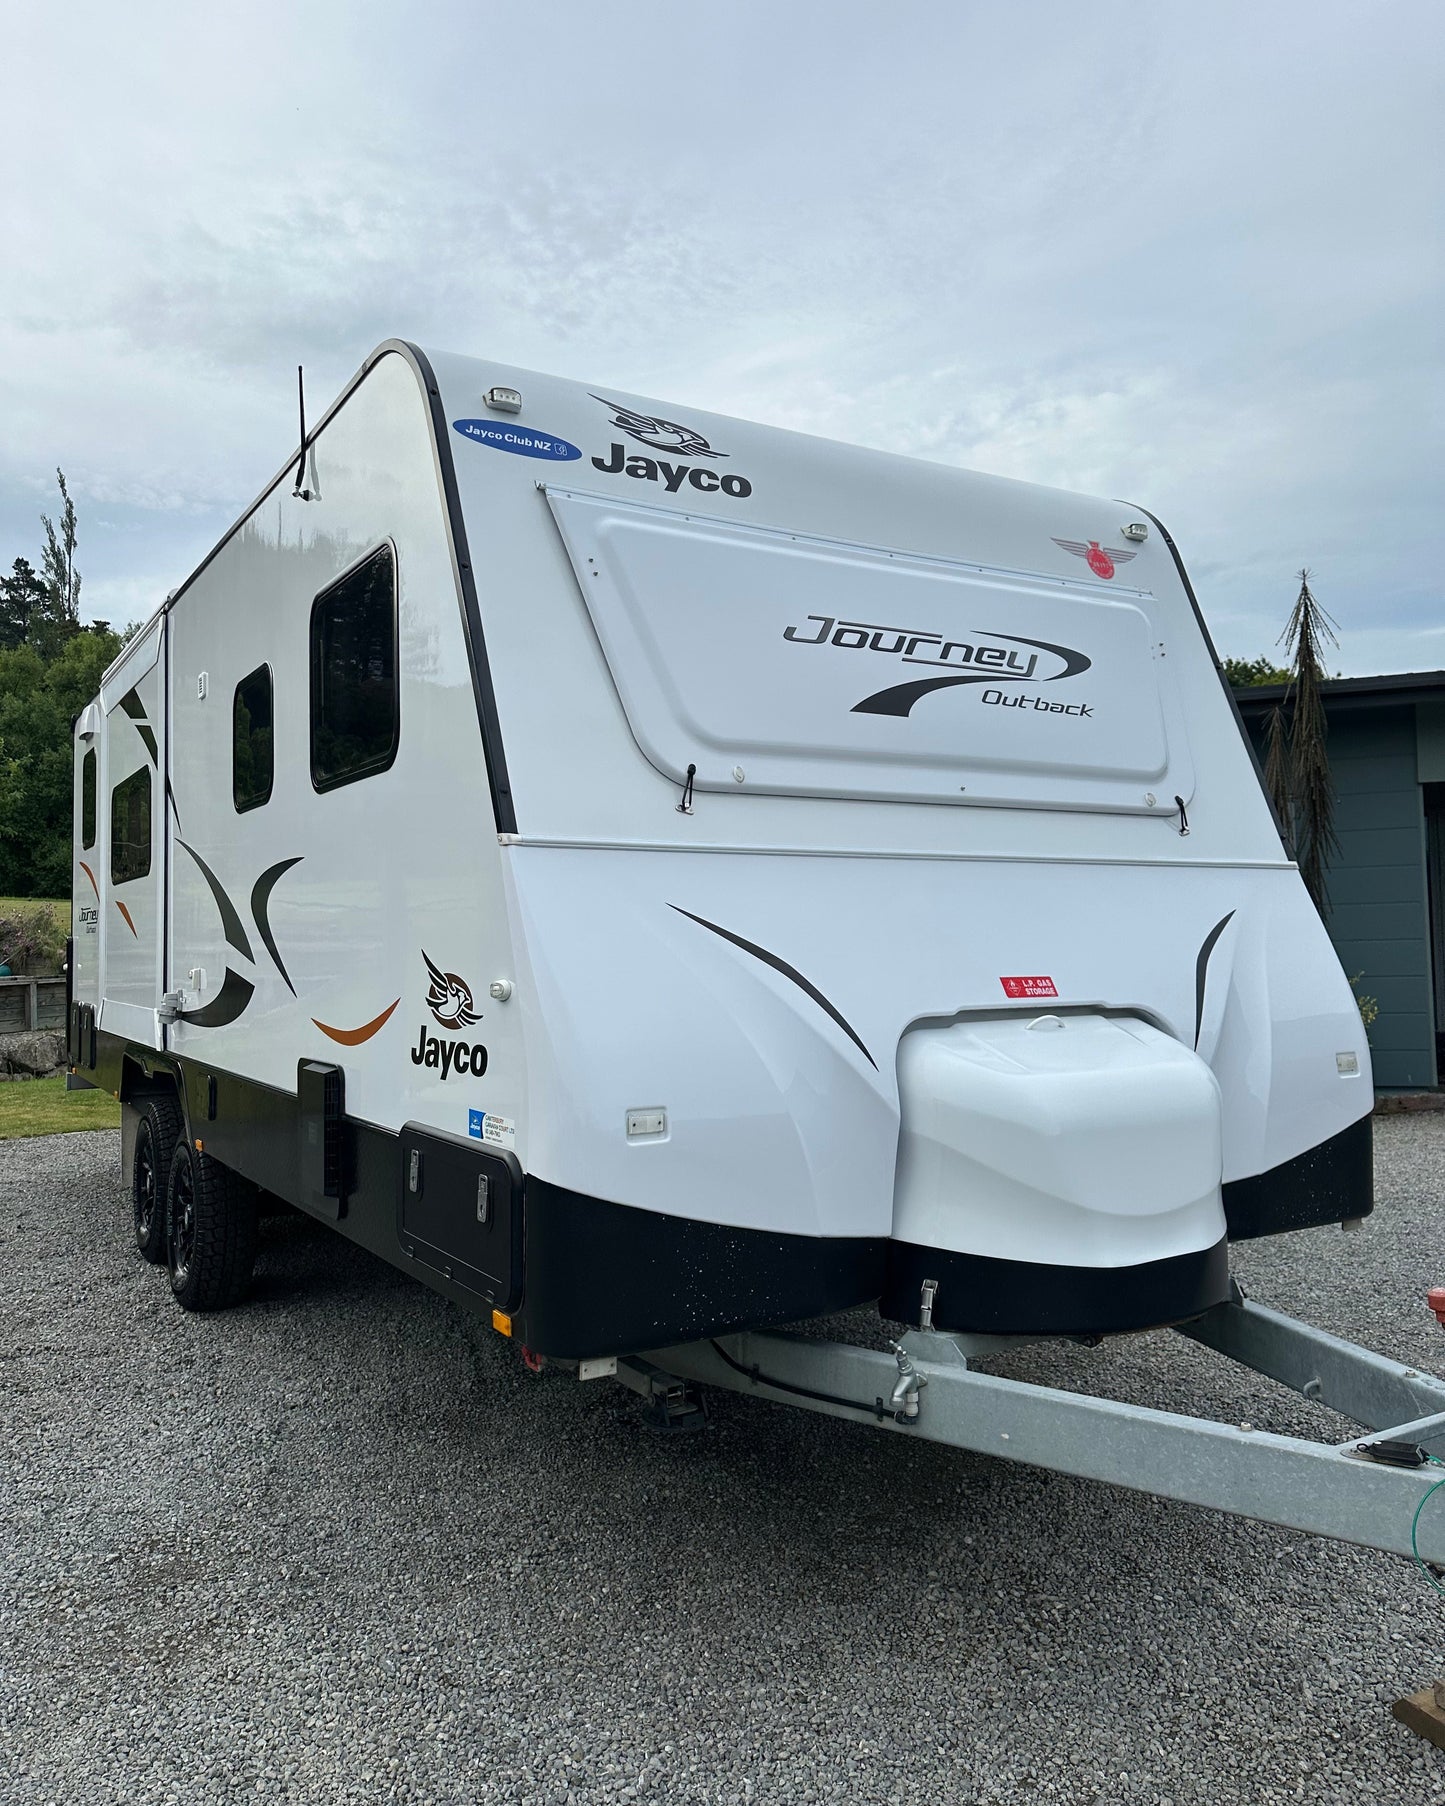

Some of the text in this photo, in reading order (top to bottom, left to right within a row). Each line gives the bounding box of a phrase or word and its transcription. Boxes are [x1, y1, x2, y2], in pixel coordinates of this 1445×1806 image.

[465, 425, 552, 451] Jayco Club NZ
[591, 442, 753, 499] Jayco
[783, 615, 1039, 679] Journey
[981, 689, 1095, 718] Outback
[1022, 979, 1052, 987] L.P. GAS
[1025, 987, 1056, 995] STORAGE
[411, 1025, 488, 1081] Jayco
